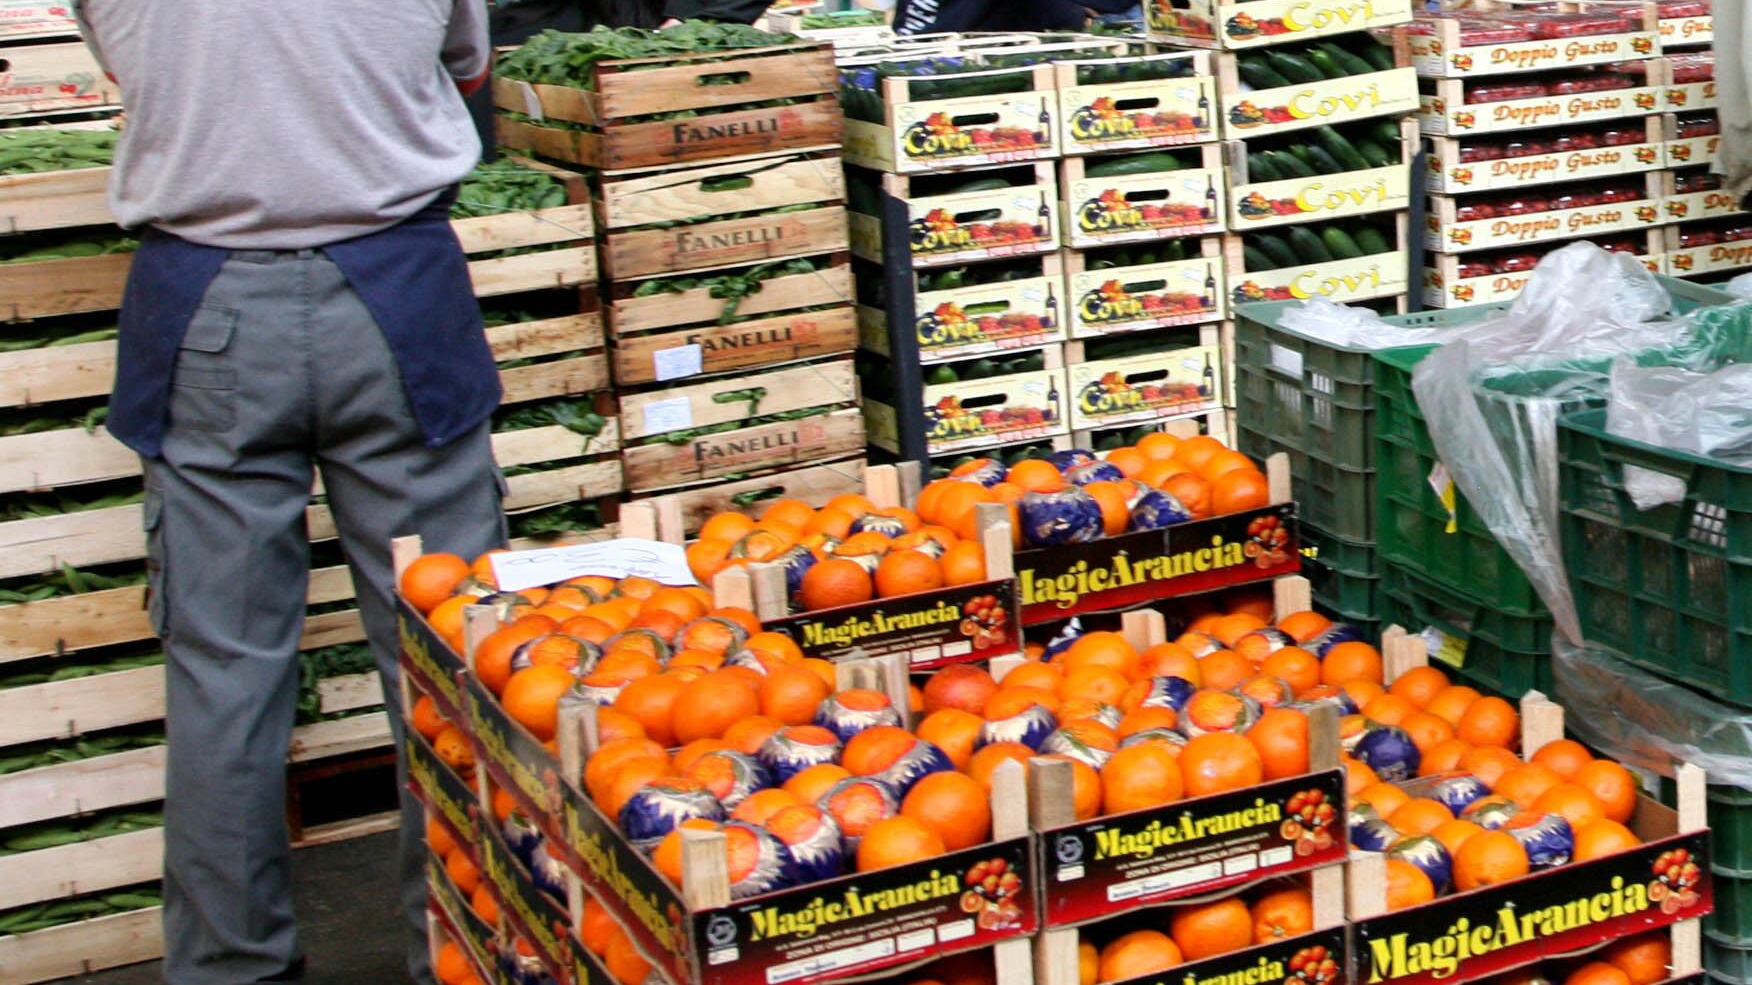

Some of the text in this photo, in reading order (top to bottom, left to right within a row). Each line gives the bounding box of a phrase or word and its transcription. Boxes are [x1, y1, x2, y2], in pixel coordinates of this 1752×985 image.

[1490, 40, 1619, 69] Doppio Gusto
[1288, 82, 1381, 120] Covi
[1493, 94, 1622, 124] Doppio Gusto
[672, 117, 779, 144] FANELLI
[1490, 149, 1621, 180] Doppio Gusto
[1295, 177, 1389, 214] Covi
[676, 225, 784, 253] FANELLI
[1490, 209, 1622, 239] Doppio Gusto
[1288, 263, 1381, 300] Covi
[693, 430, 799, 462] FANELLI
[802, 600, 961, 648] MagicArancia
[1093, 797, 1283, 862] MagicArancia
[751, 869, 960, 942] MagicArancia
[1367, 874, 1650, 985] MagicArancia
